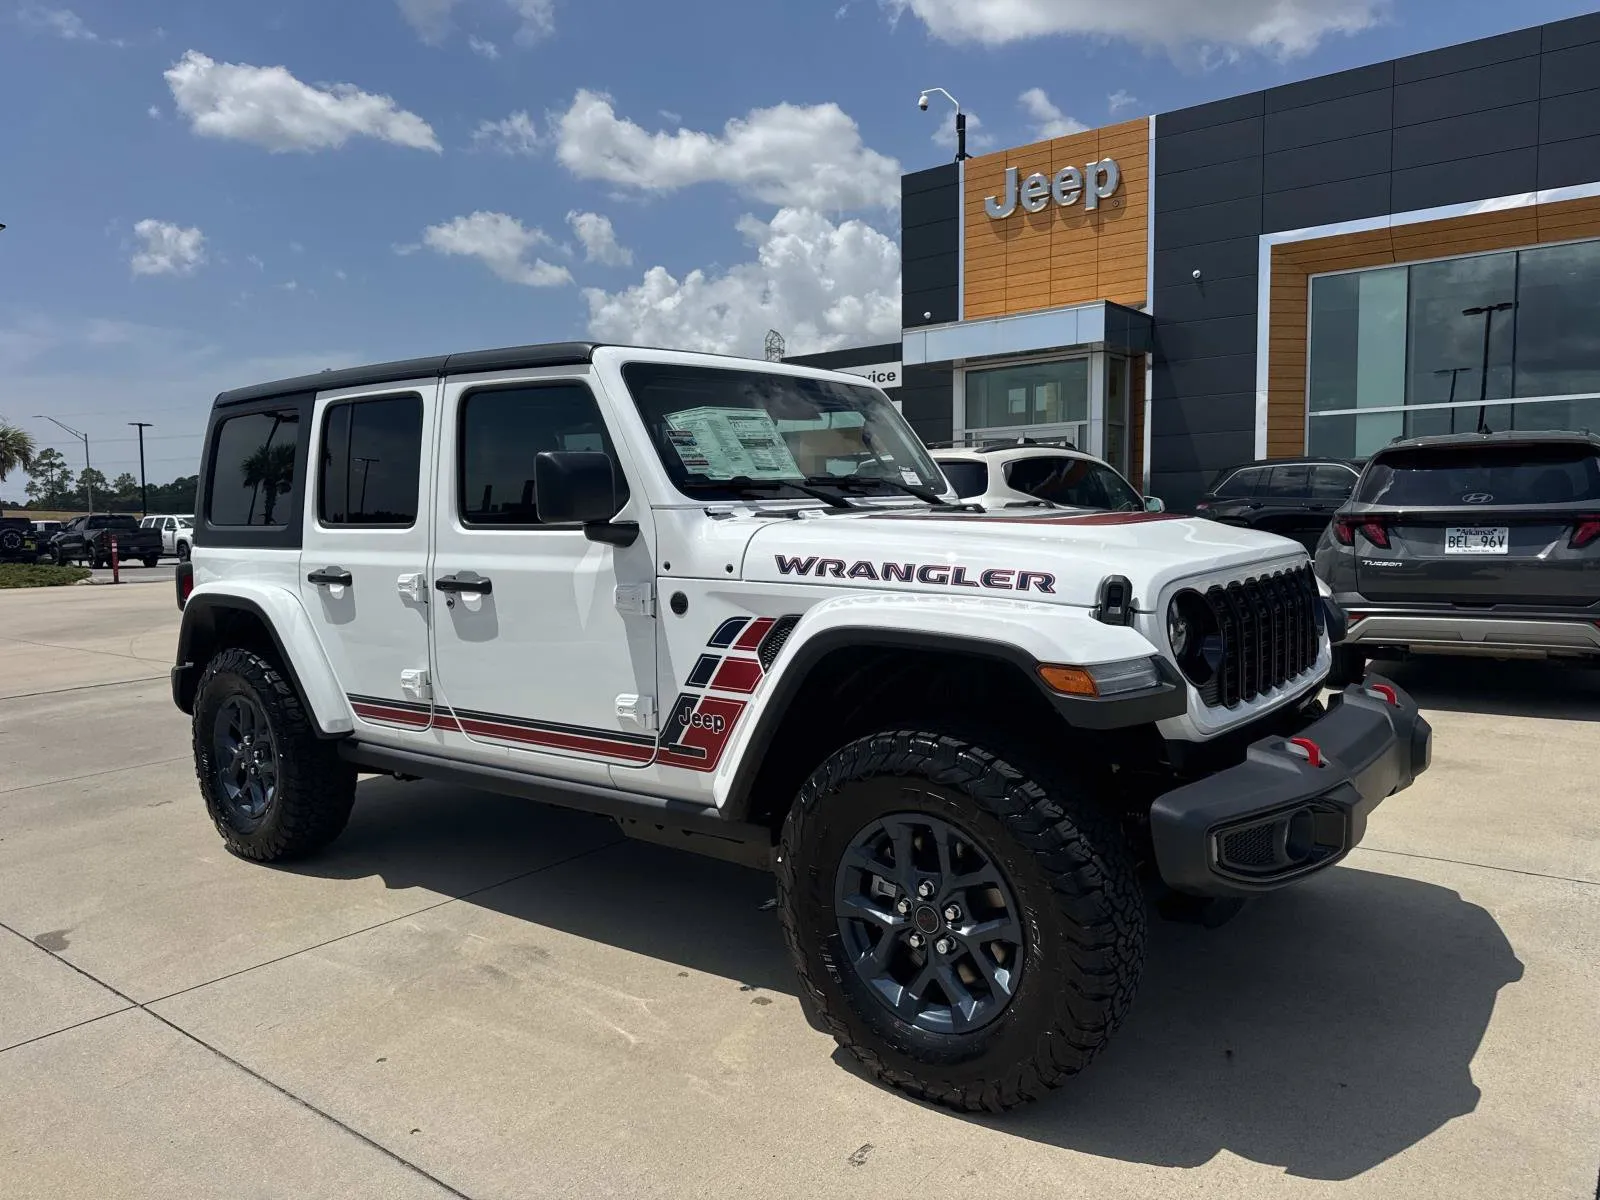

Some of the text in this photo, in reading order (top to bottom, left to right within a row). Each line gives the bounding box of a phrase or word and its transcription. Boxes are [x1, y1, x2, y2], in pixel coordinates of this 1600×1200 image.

[984, 157, 1120, 220] Jeep
[1448, 535, 1505, 548] BEL 96V
[1460, 528, 1494, 536] Arkansas
[774, 553, 1057, 594] WRANGLER
[678, 706, 726, 735] Jeep
